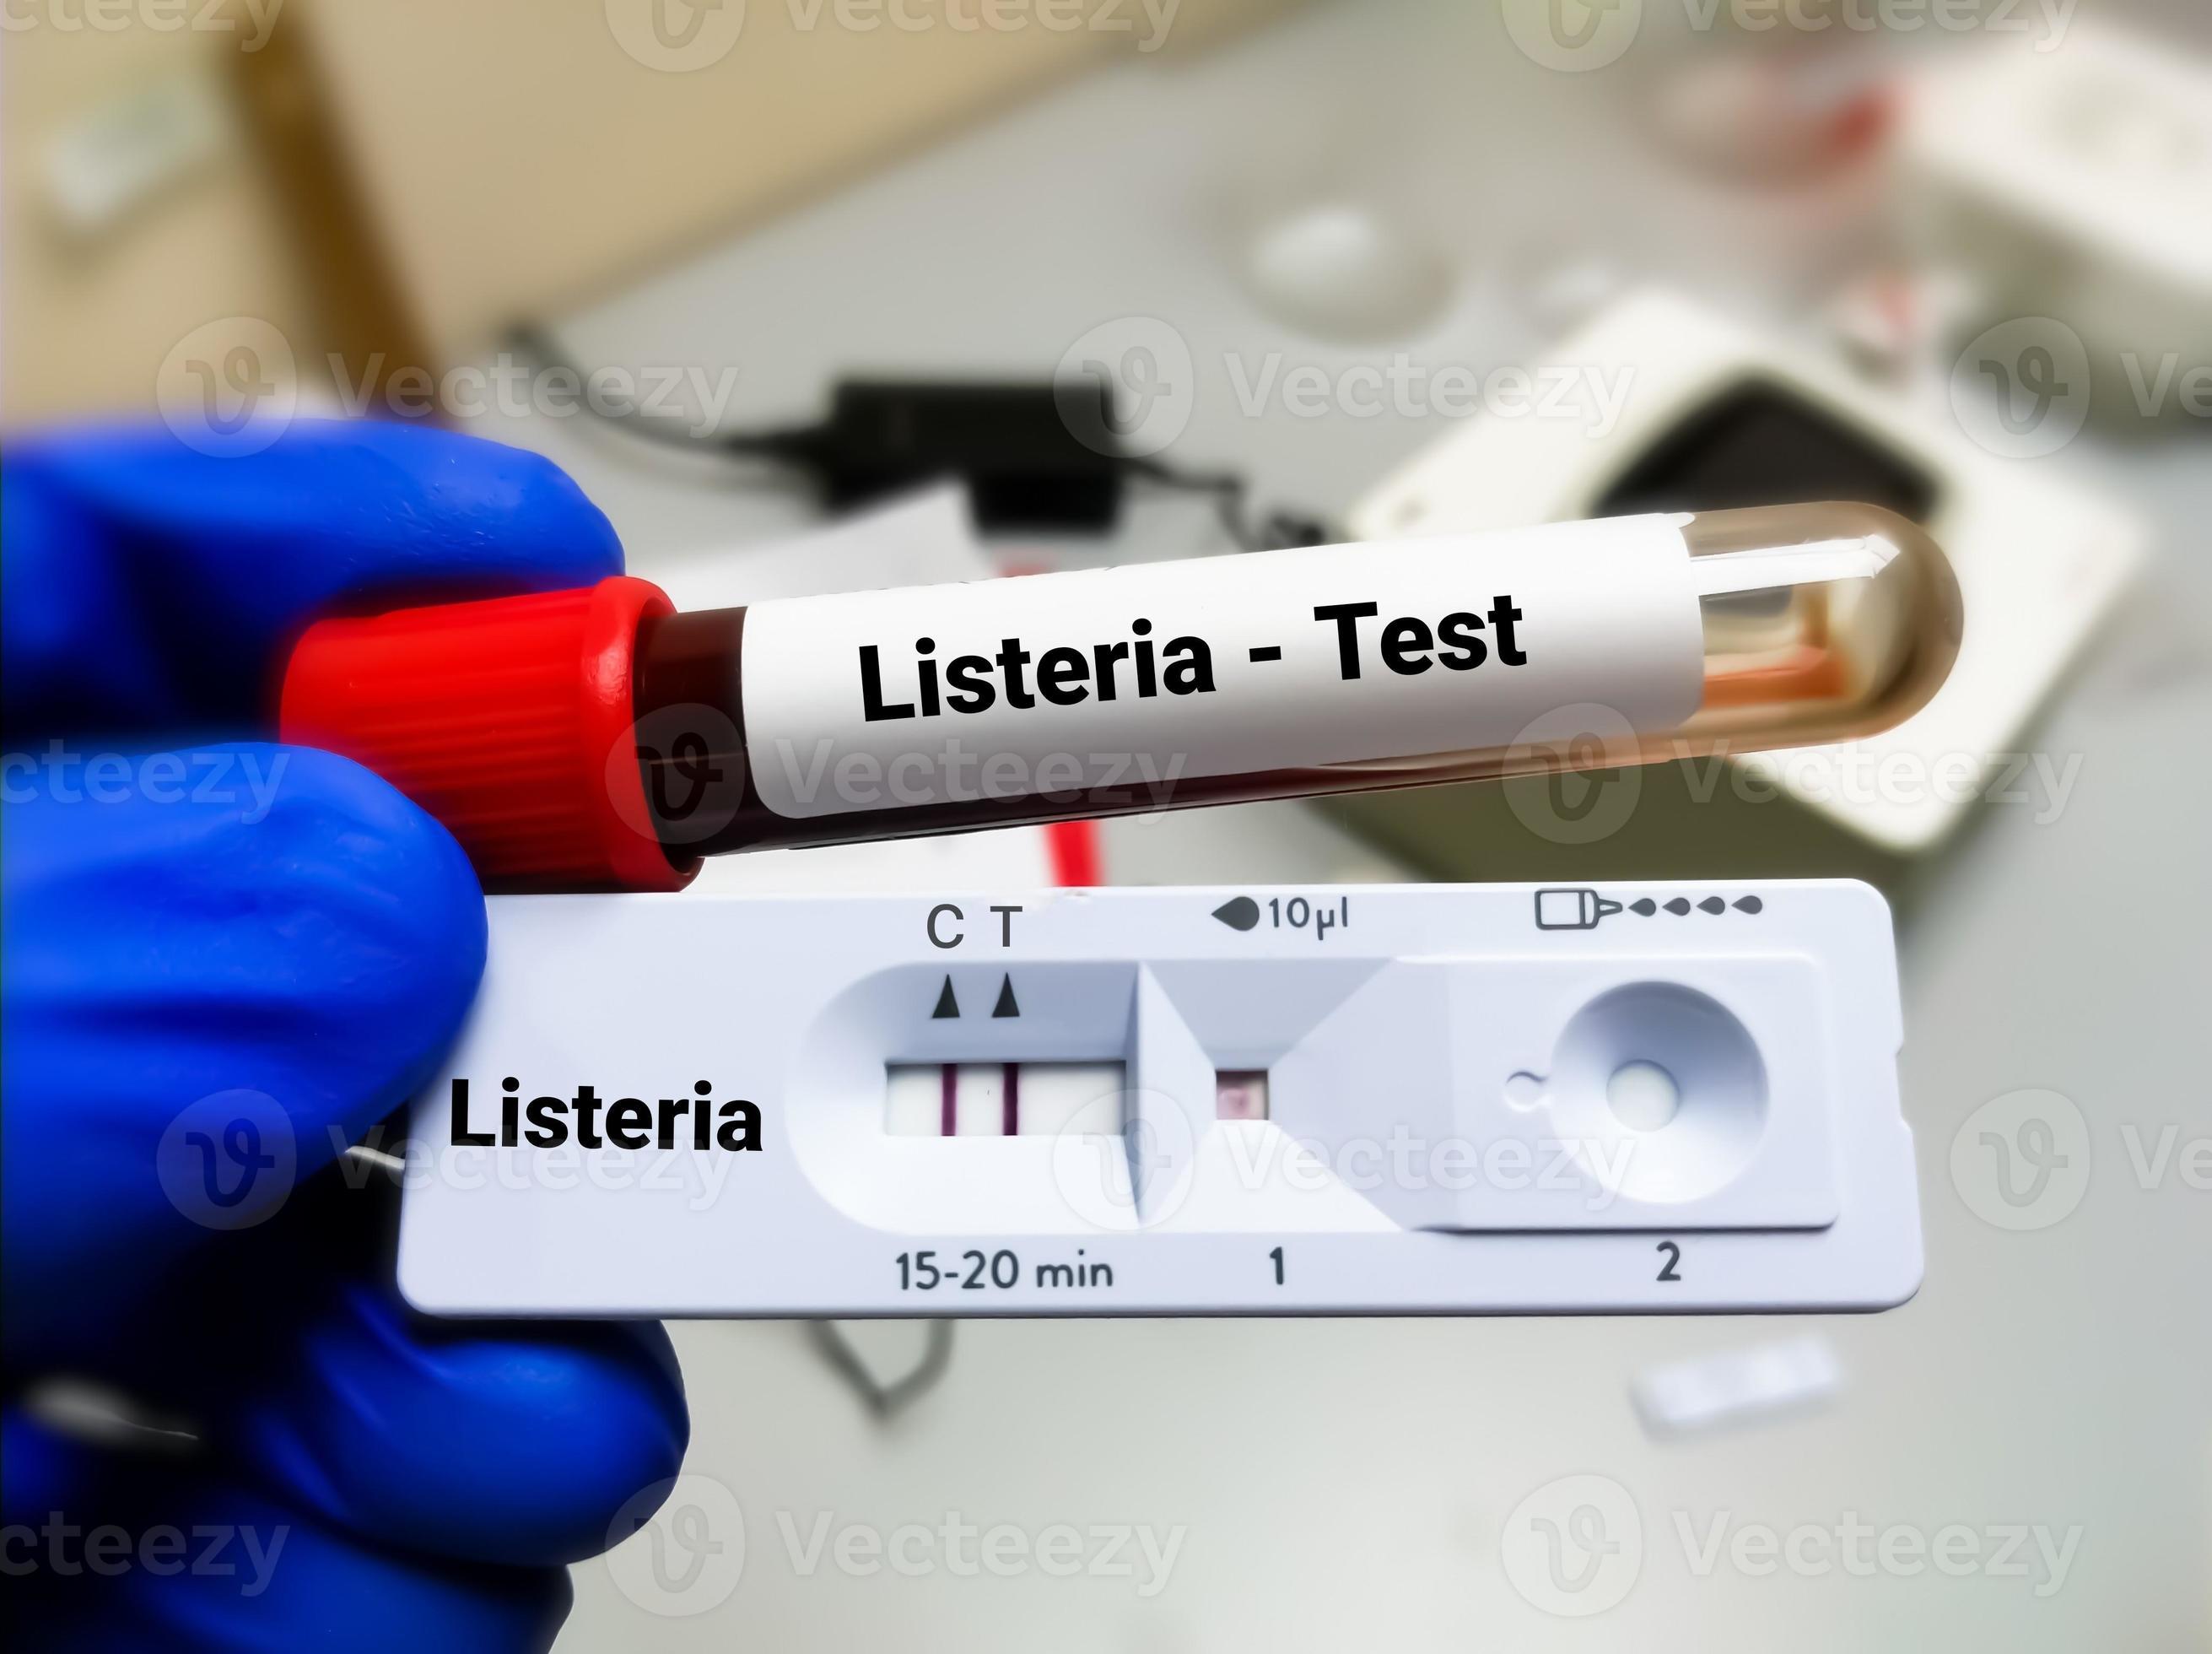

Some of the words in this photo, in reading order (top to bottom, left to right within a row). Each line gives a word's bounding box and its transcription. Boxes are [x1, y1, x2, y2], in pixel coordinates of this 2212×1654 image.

[859, 618, 1217, 722] Listeria
[1249, 646, 1281, 662] -
[1314, 595, 1528, 681] Test
[926, 903, 964, 949] C
[990, 905, 1023, 948] T
[450, 1077, 763, 1152] Listeria
[896, 1249, 1019, 1290] 15-20
[1036, 1249, 1114, 1288] min
[1269, 1246, 1284, 1285] 1
[1656, 1240, 1681, 1281] 2
